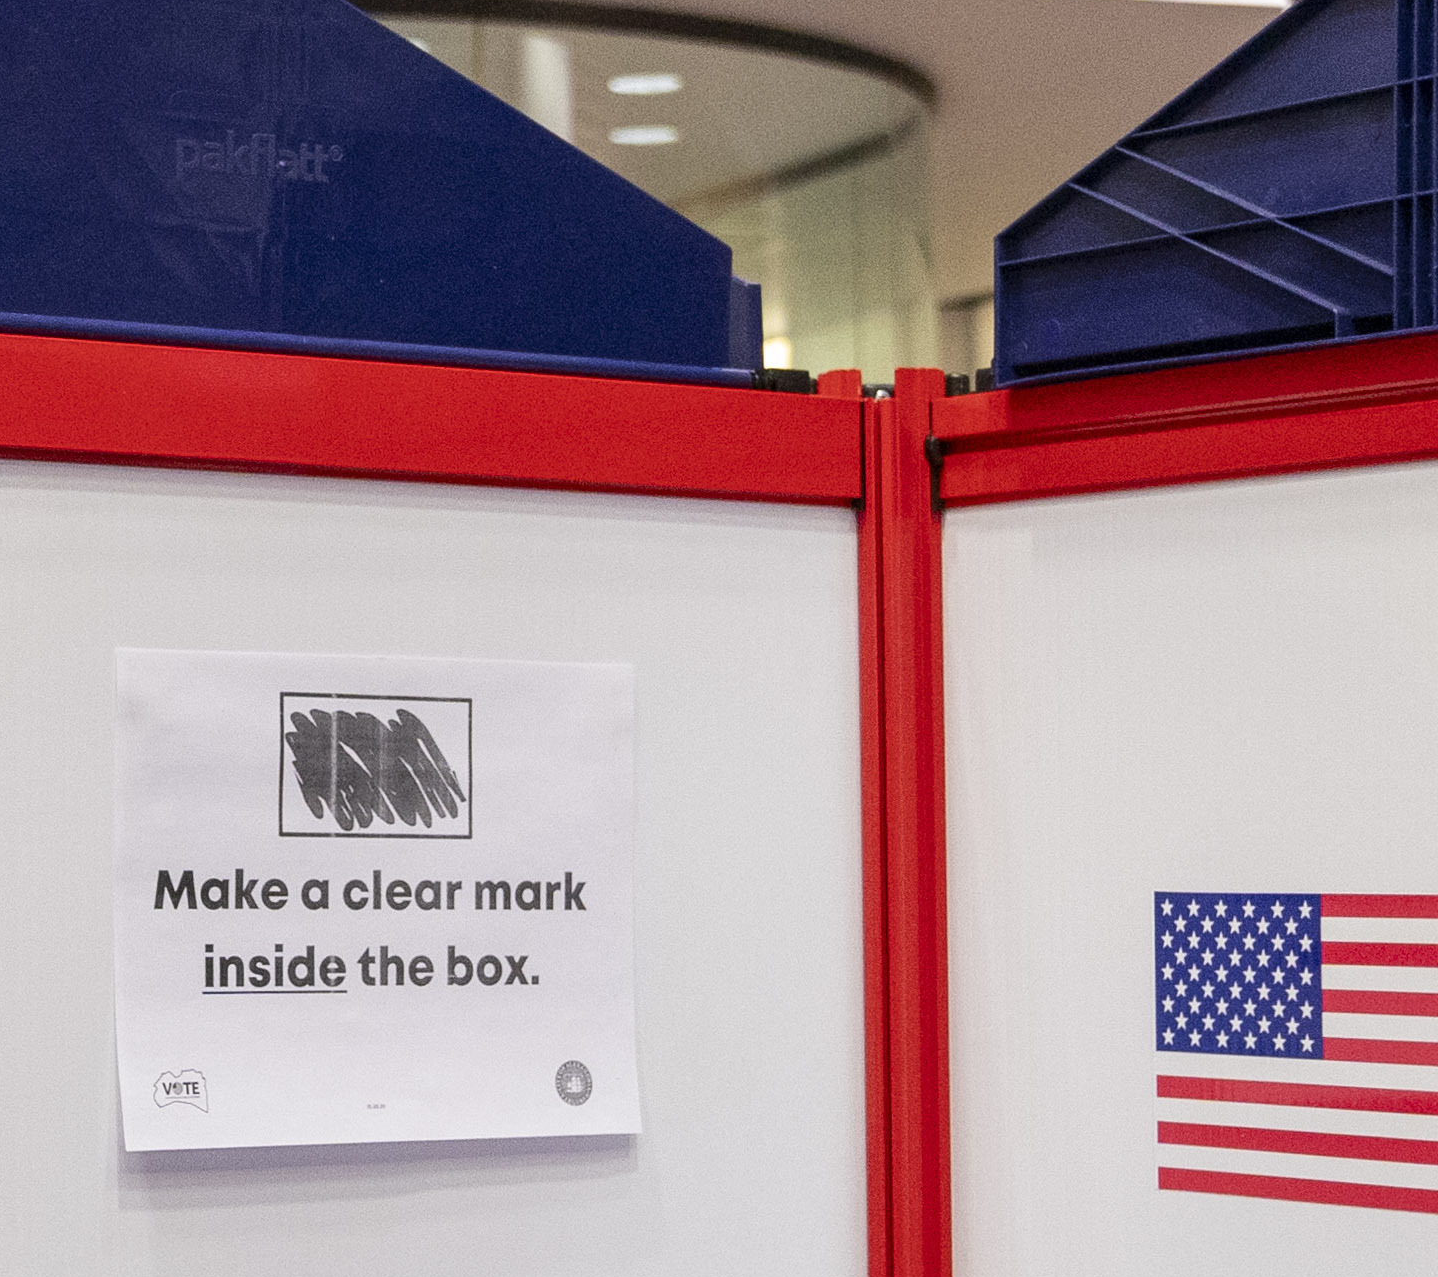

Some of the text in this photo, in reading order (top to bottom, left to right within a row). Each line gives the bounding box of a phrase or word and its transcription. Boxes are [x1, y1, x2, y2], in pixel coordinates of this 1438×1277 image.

[154, 868, 587, 911] Make a clear mark
[203, 943, 540, 991] inside the box.
[162, 1081, 200, 1096] VOTE
